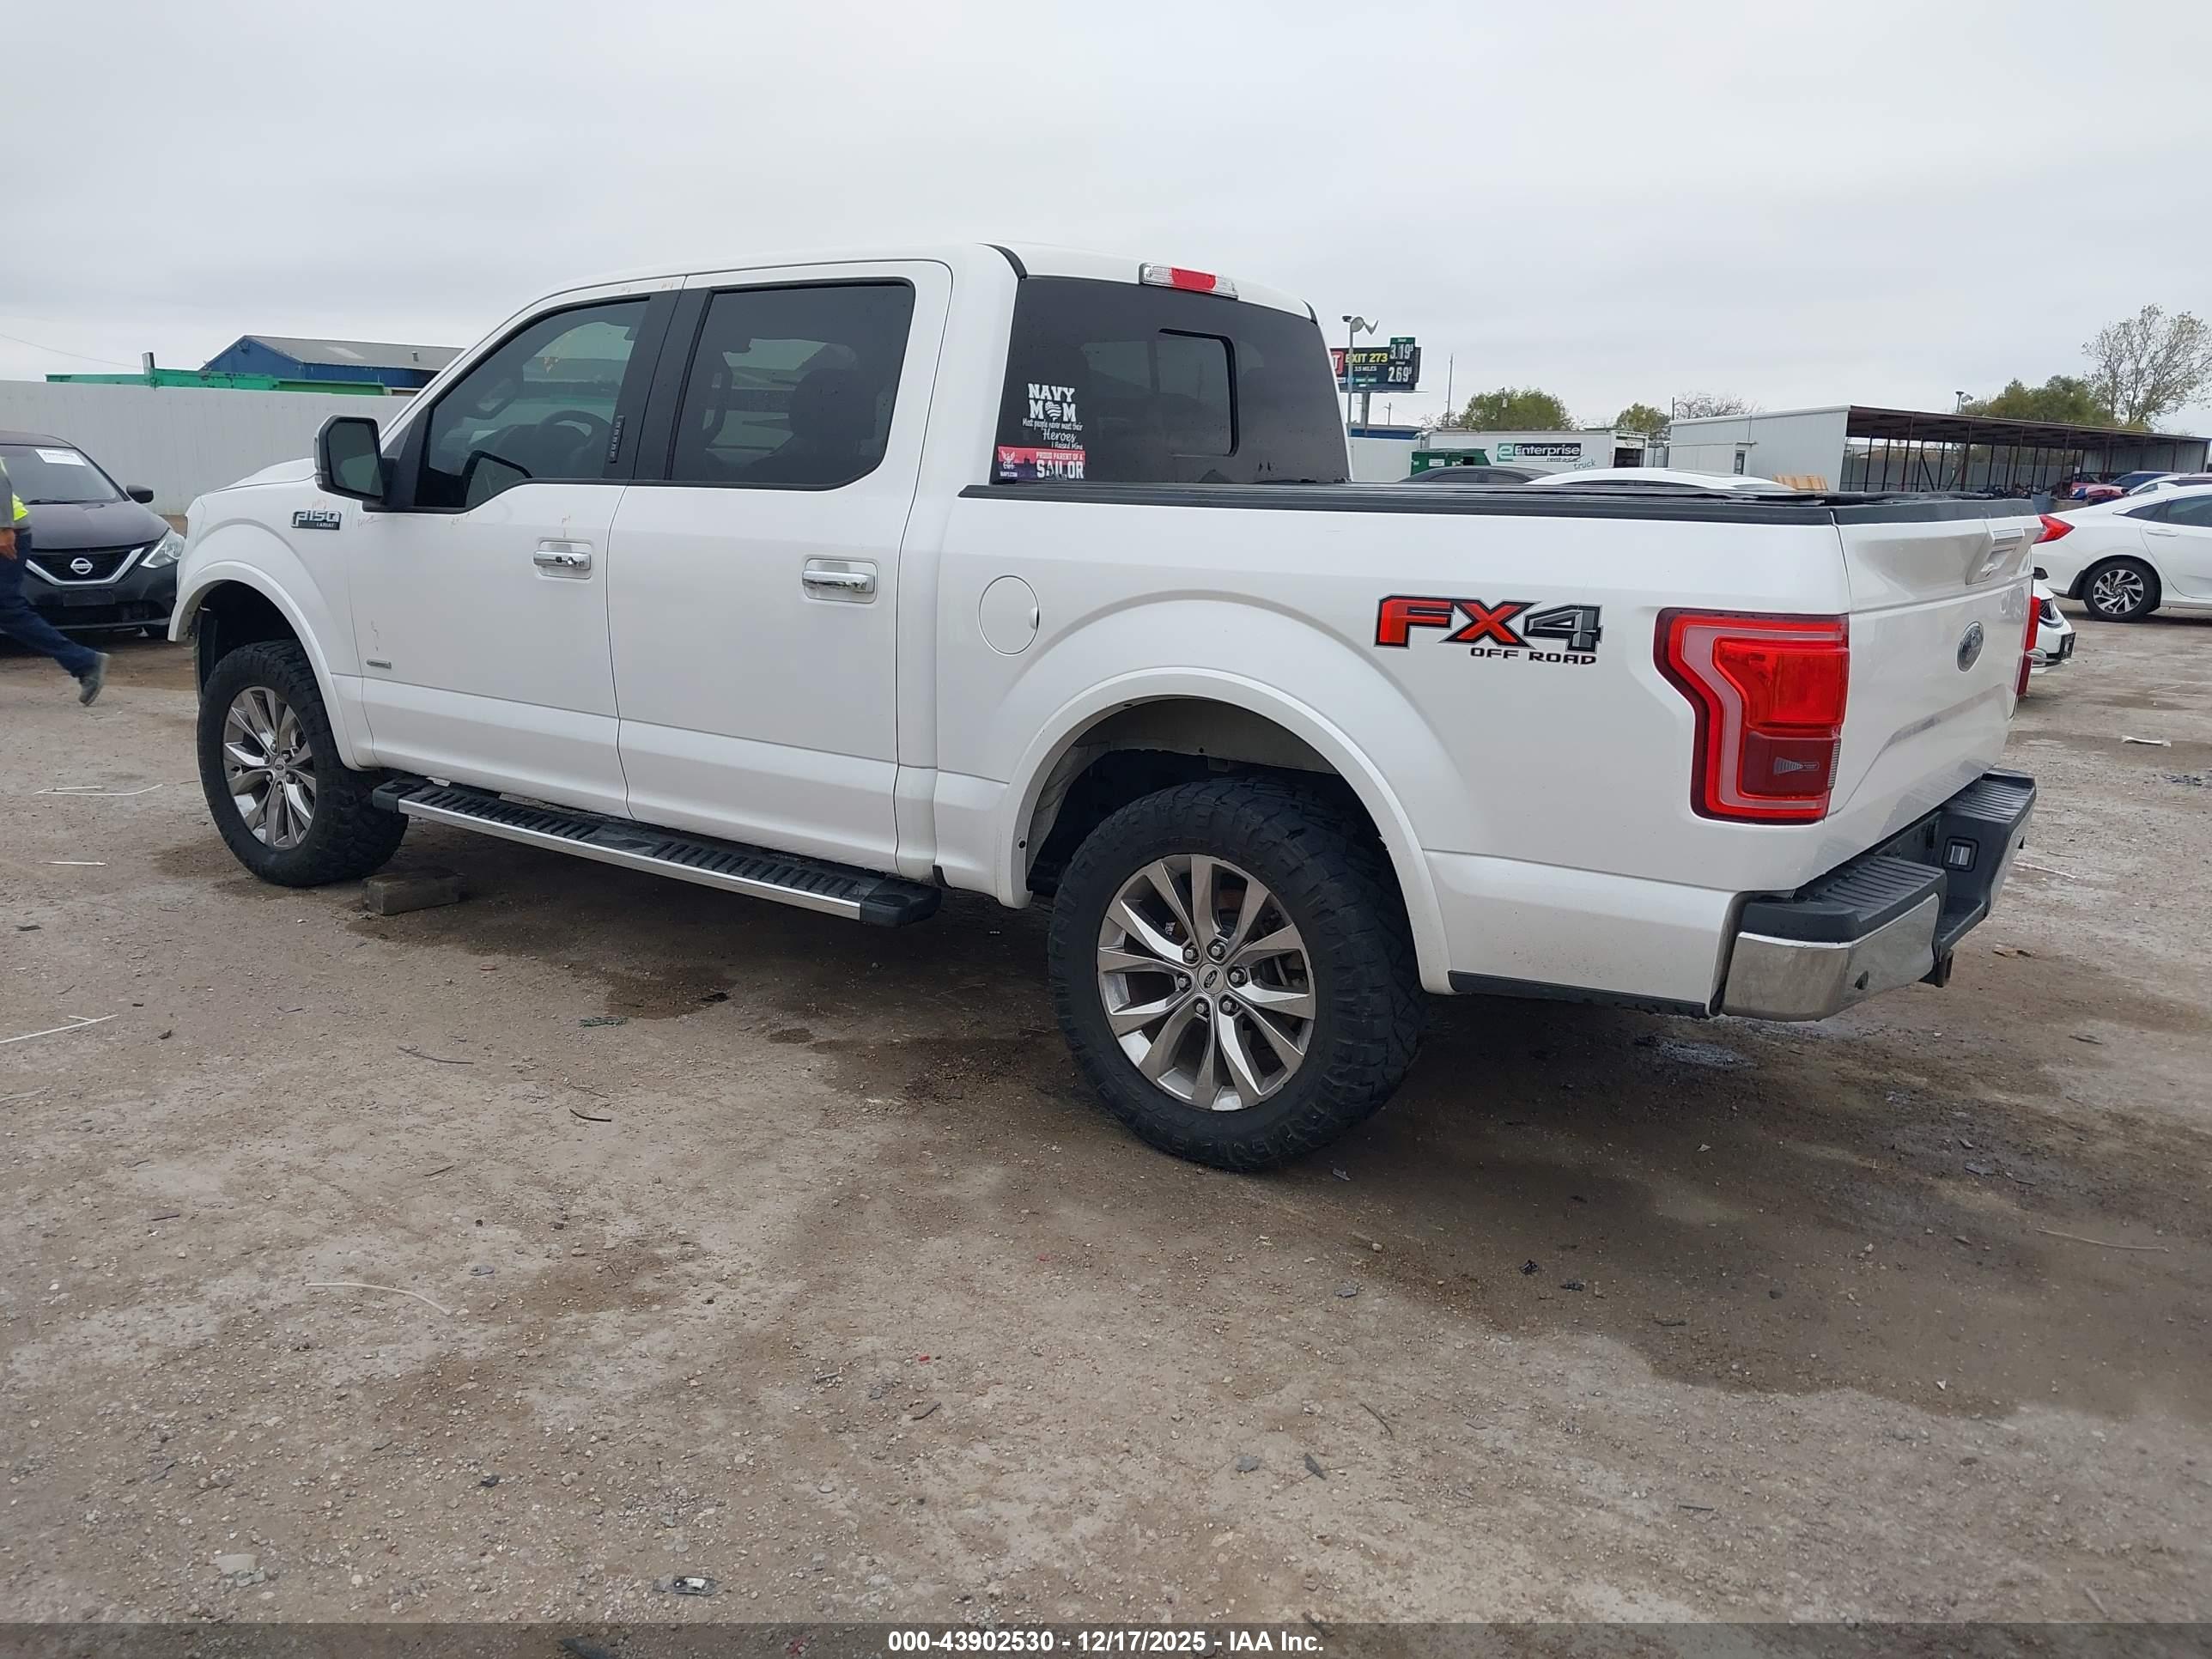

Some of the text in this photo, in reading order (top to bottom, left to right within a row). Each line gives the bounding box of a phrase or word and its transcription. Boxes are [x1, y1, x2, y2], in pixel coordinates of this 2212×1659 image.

[1345, 353, 1367, 363] EXIT
[1369, 353, 1389, 362] 273
[1027, 383, 1075, 402] NAVY
[1029, 399, 1077, 422] MM
[1042, 428, 1077, 443] Heroes
[1515, 445, 1580, 456] Enterprise
[1036, 459, 1084, 479] SAILOR
[1573, 459, 1596, 470] truck
[1374, 592, 1604, 653] FX4
[1470, 647, 1597, 665] OFF ROAD
